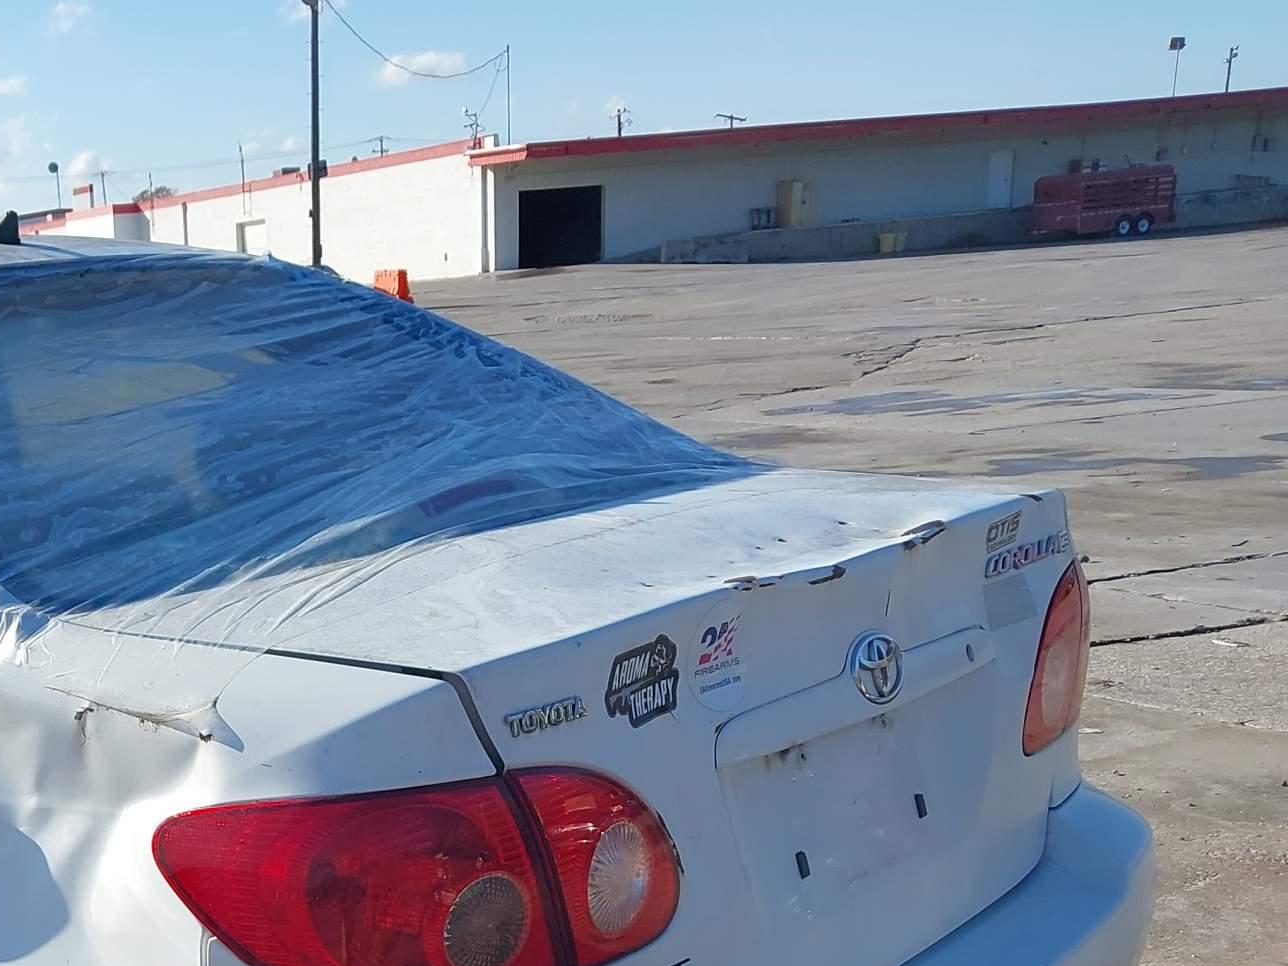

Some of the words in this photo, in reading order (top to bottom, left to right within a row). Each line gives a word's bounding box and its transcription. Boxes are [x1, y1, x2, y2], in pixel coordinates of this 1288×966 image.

[986, 511, 1022, 544] OTIS
[612, 650, 651, 692] AROMA
[504, 695, 588, 738] TOYOTA
[629, 676, 674, 720] THERAPY
